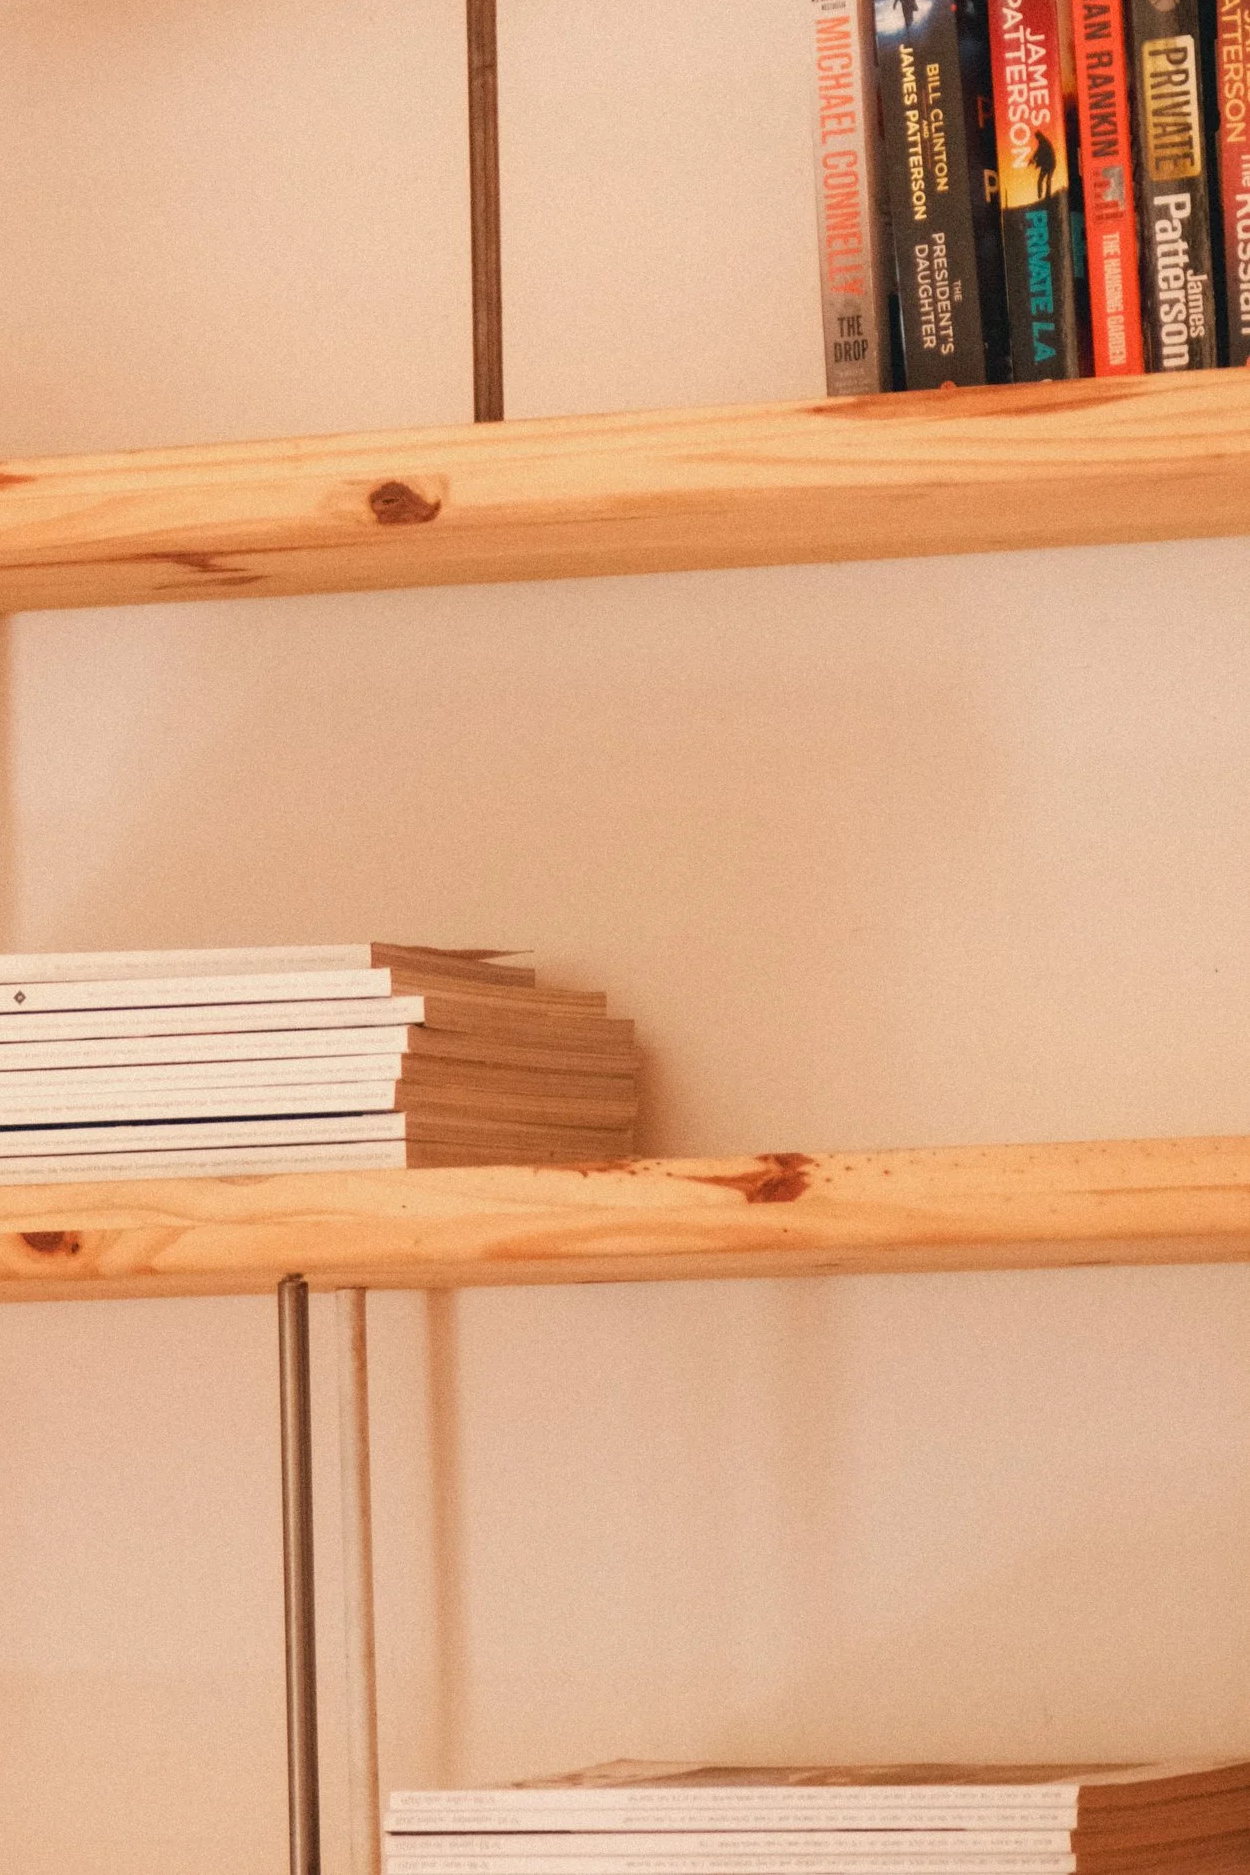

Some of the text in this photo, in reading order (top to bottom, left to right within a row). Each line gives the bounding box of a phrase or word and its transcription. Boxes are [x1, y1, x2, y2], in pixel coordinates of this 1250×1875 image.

[814, 15, 855, 143] MICHAEL
[926, 64, 949, 192] BILL CLINTON
[1025, 28, 1050, 126] JAMES
[1085, 52, 1119, 158] RANKIN
[1146, 46, 1195, 174] PRIVATE
[898, 44, 928, 221] JAMES PATTERSON
[823, 150, 865, 295] CONNELLY
[1025, 211, 1053, 315] PRIVATE
[1101, 232, 1120, 255] THE
[837, 315, 863, 338] THE
[914, 244, 936, 349] DAUGHTER
[930, 232, 956, 355] PRESIDENT'S
[953, 280, 962, 301] THE
[1104, 258, 1124, 312] HANGING
[1152, 193, 1192, 368] Patterson
[1186, 270, 1207, 337] James
[834, 339, 869, 363] DROP
[1107, 315, 1127, 366] GARDEN
